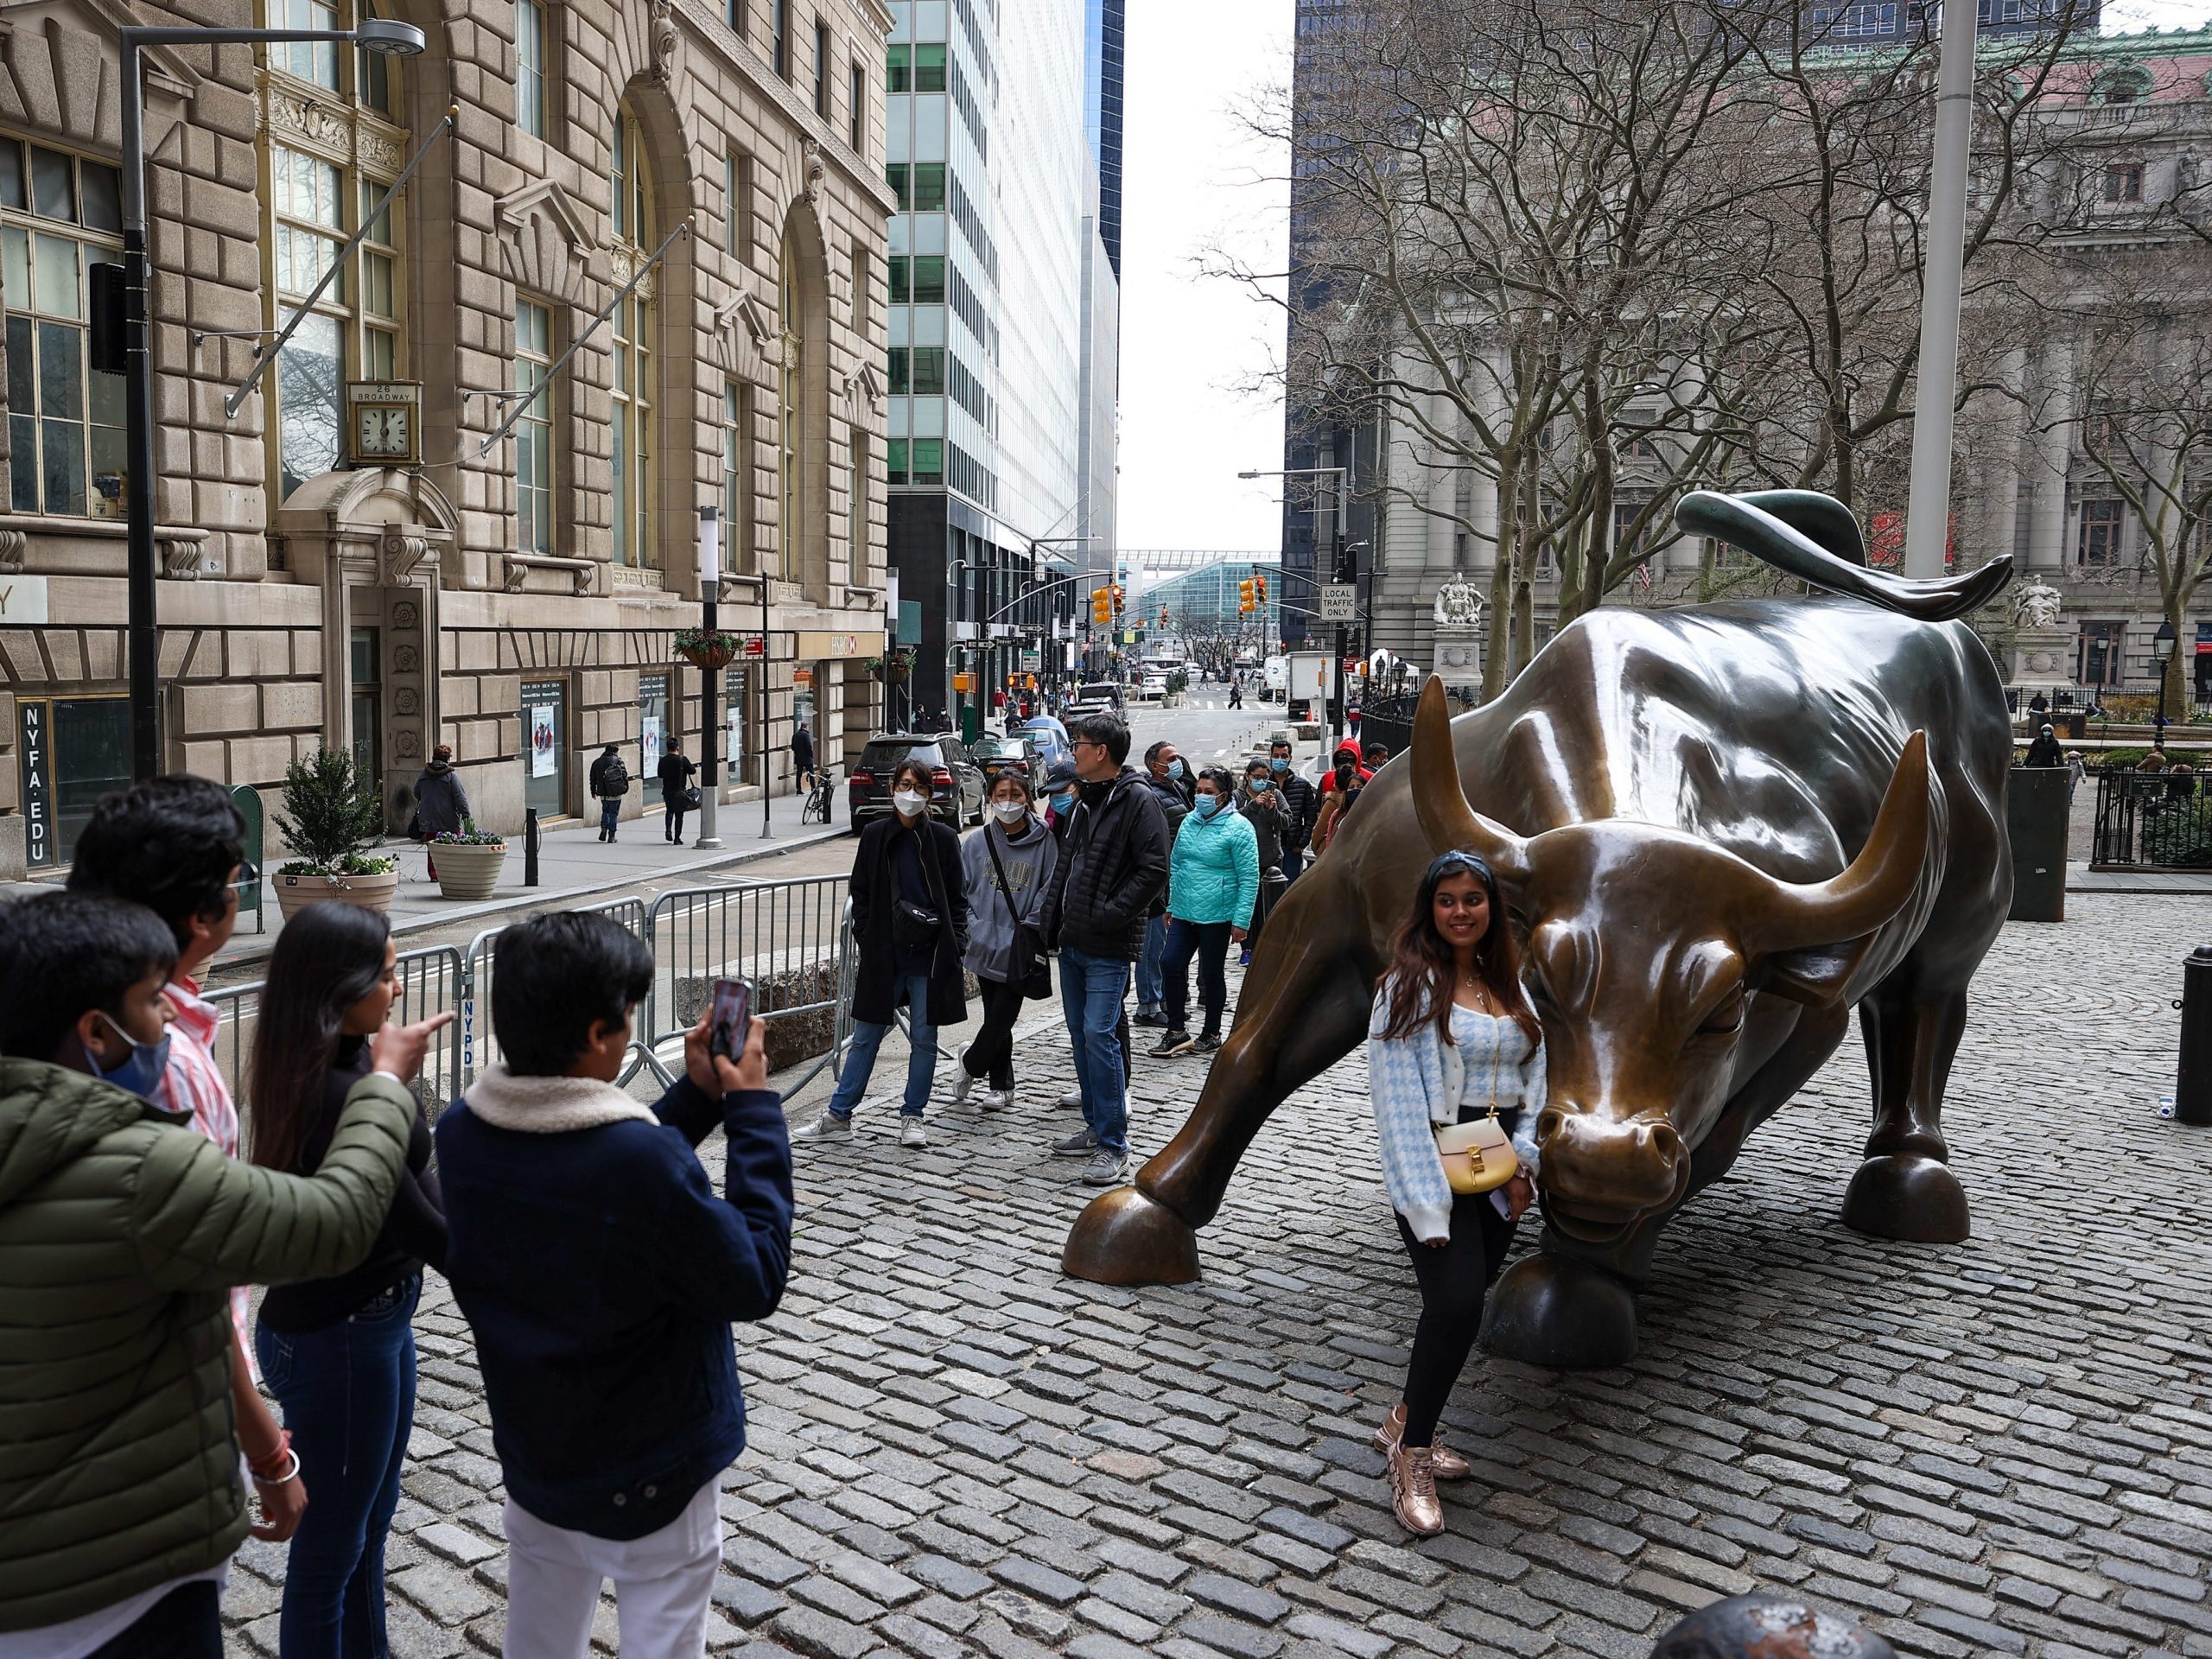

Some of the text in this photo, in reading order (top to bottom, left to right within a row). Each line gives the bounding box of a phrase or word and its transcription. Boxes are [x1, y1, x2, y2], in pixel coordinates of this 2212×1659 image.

[377, 385, 391, 393] 26
[831, 635, 849, 656] HSBC
[464, 1001, 473, 1065] NYPD
